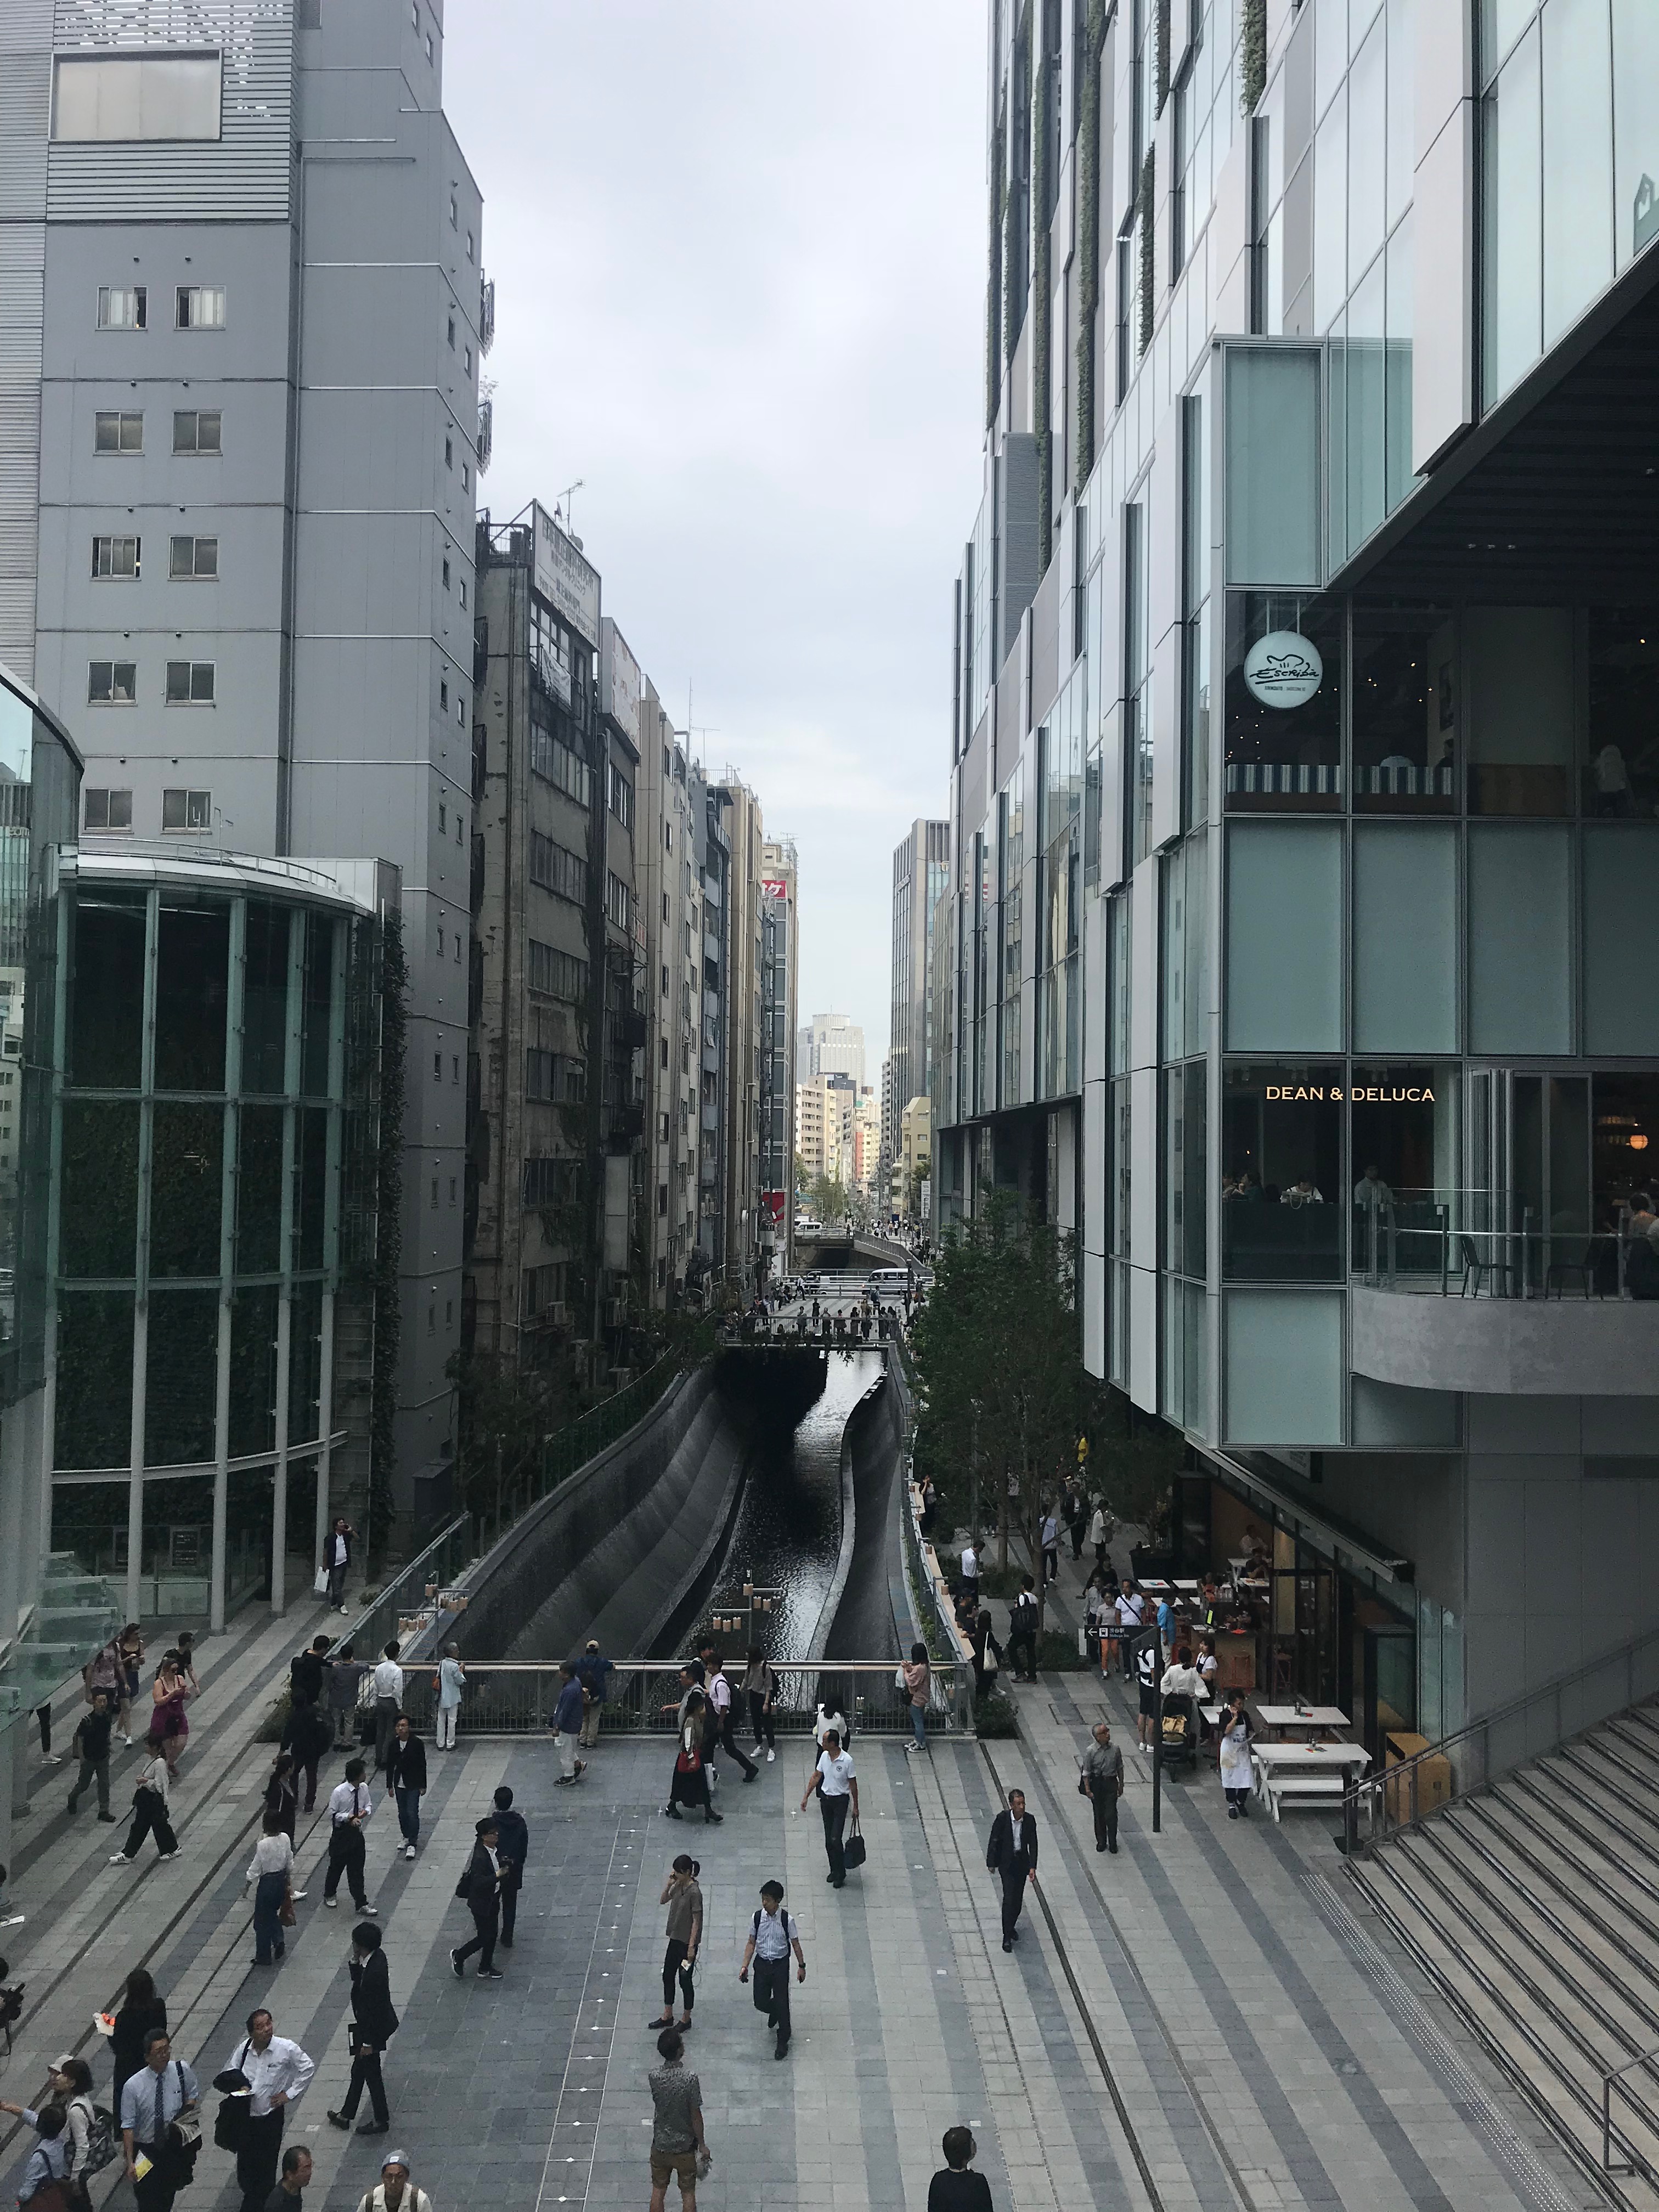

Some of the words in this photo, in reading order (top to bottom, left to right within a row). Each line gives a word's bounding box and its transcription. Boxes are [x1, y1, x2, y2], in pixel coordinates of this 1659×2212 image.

[1266, 1086, 1323, 1101] DEAN
[1330, 1087, 1344, 1101] &
[1351, 1087, 1435, 1102] DELUCA
